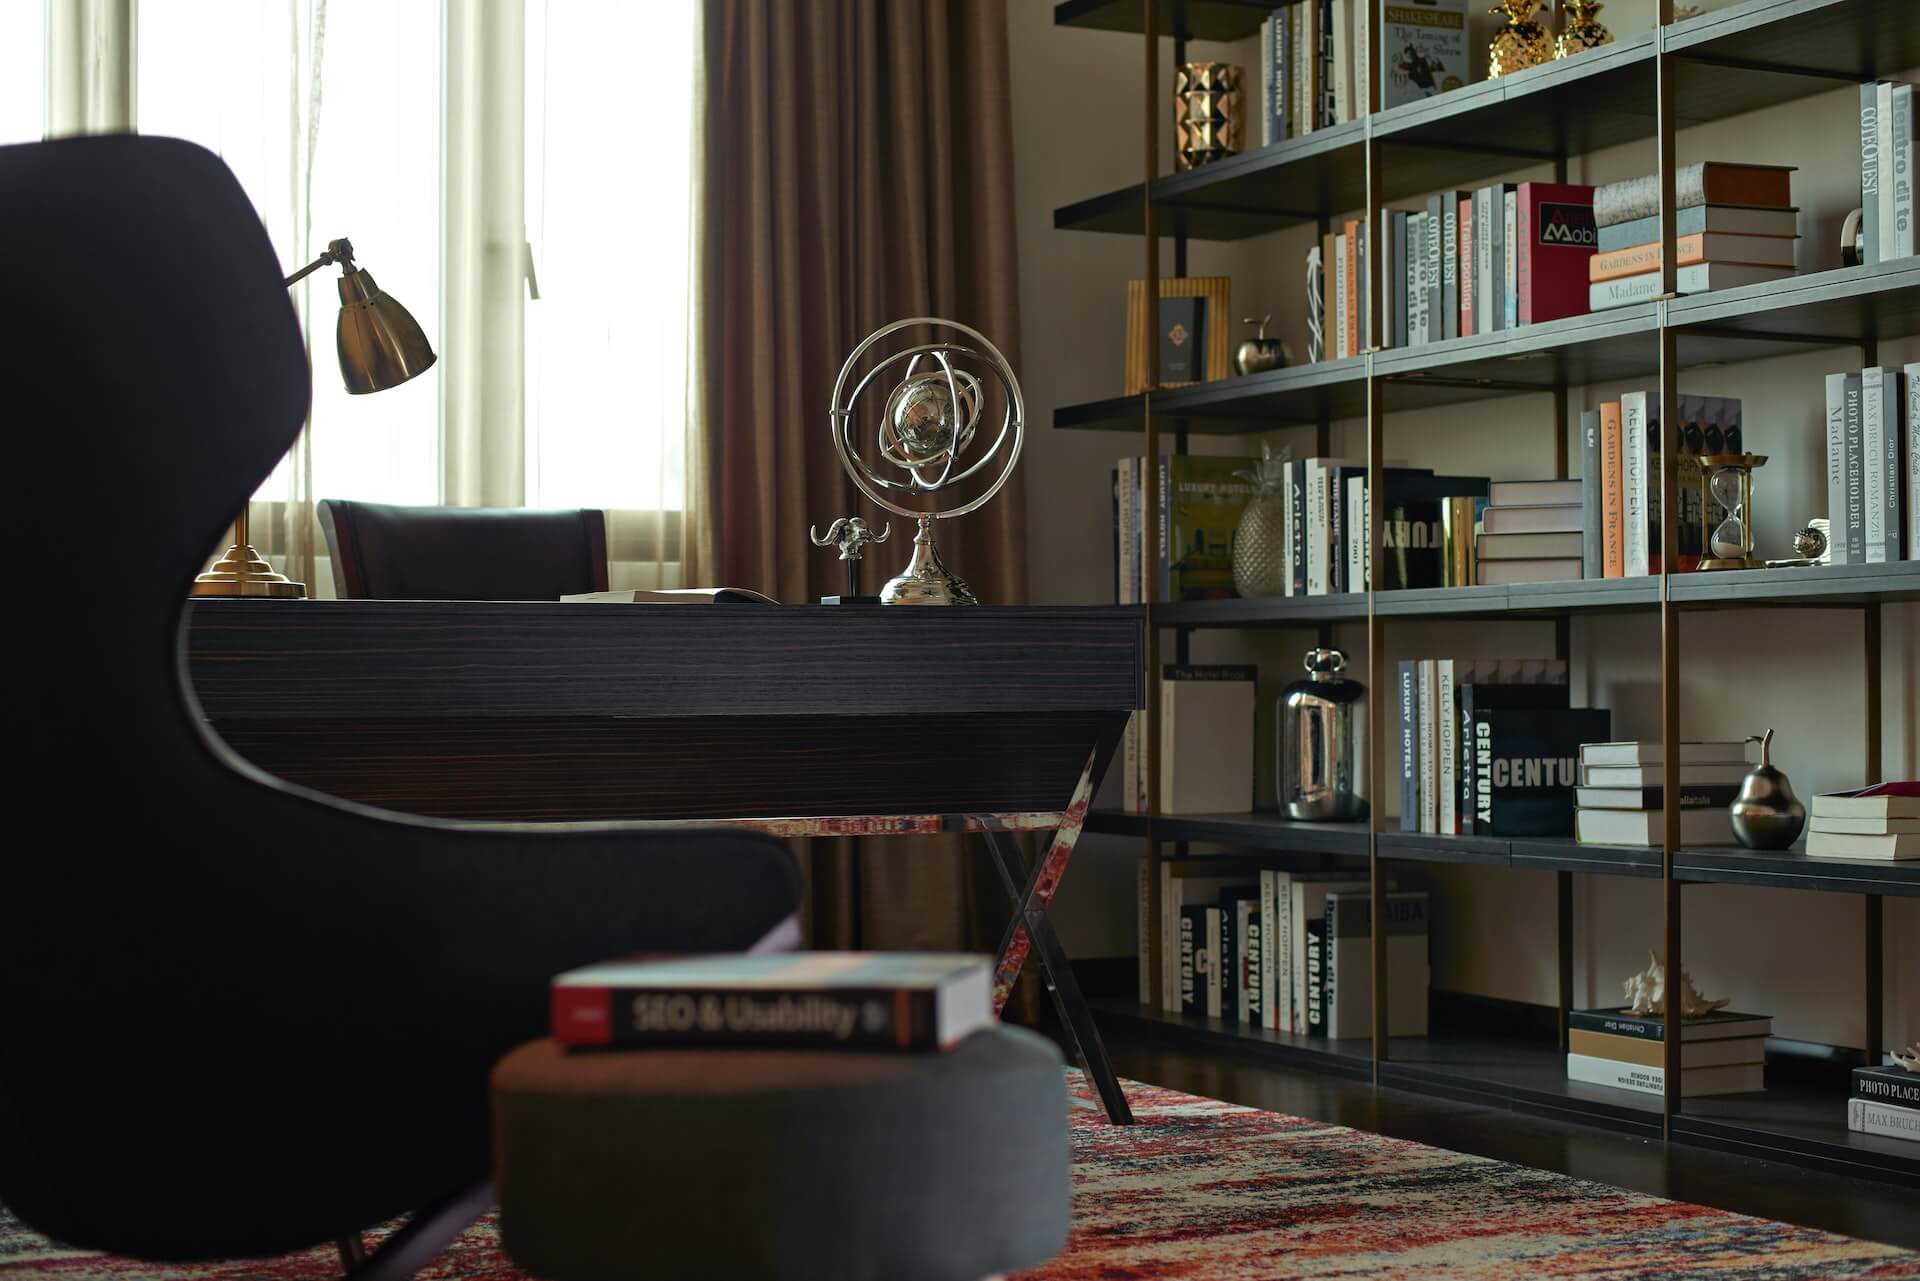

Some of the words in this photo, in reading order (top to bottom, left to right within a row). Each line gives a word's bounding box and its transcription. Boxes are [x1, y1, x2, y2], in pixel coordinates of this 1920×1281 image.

[1388, 9, 1462, 27] SHAKESPEARE
[1416, 29, 1449, 43] Taming
[1275, 17, 1284, 65] LUXURY
[1275, 69, 1284, 117] HOTELS
[1894, 94, 1910, 175] Dentro
[1896, 180, 1910, 203] di
[1896, 207, 1910, 233] te
[1407, 222, 1418, 285] Dentro
[1462, 217, 1473, 312] Trainspotting
[1600, 254, 1643, 272] GARDENS
[1644, 251, 1655, 262] IN
[1408, 290, 1418, 309] di
[1419, 286, 1429, 304] di
[1608, 281, 1657, 301] Madame
[1408, 312, 1418, 332] te
[1419, 307, 1429, 328] te
[1848, 390, 1858, 434] PHOTO
[1867, 392, 1877, 420] MAX
[1628, 408, 1639, 450] KELLY
[1830, 407, 1843, 485] Madame
[1868, 422, 1879, 472] BRUCH
[1888, 439, 1896, 459] Dior
[1607, 418, 1617, 491] GARDENS
[1609, 492, 1617, 504] IN
[1629, 455, 1639, 517] HOPPEN
[1848, 436, 1860, 530] PLACEHOLDER
[1888, 463, 1896, 509] Christian
[1293, 483, 1302, 567] Arletta
[1870, 473, 1881, 539] ROMANZE
[1383, 520, 1442, 549] TURY
[1608, 511, 1618, 569] FRANCE
[1403, 672, 1411, 723] LUXURY
[1441, 674, 1449, 715] KELLY
[1404, 729, 1412, 779] HOTELS
[1443, 719, 1452, 775] HOPPEN
[1463, 709, 1472, 800] Arletta
[1475, 721, 1492, 824] CENTURY
[1493, 757, 1580, 789] CENTU
[1221, 909, 1230, 989] Arletta
[1265, 922, 1273, 974] HOPPEN
[1327, 900, 1335, 961] Dentro
[1181, 916, 1194, 1005] CENTURY
[1248, 923, 1261, 1014] CENTURY
[1307, 931, 1321, 1025] CENTURY
[1327, 966, 1335, 984] di
[631, 993, 693, 1031] SEO
[698, 994, 723, 1031] &
[726, 993, 861, 1040] Usability
[1327, 988, 1335, 1006] te
[1604, 1021, 1617, 1031] Dior
[1618, 1023, 1646, 1034] Christian
[1617, 1076, 1636, 1086] DESIGN
[1636, 1079, 1663, 1091] FURNITURE
[1651, 1075, 1663, 1084] IDEA
[1859, 1079, 1889, 1097] PHOTO
[1868, 1111, 1888, 1127] MAX
